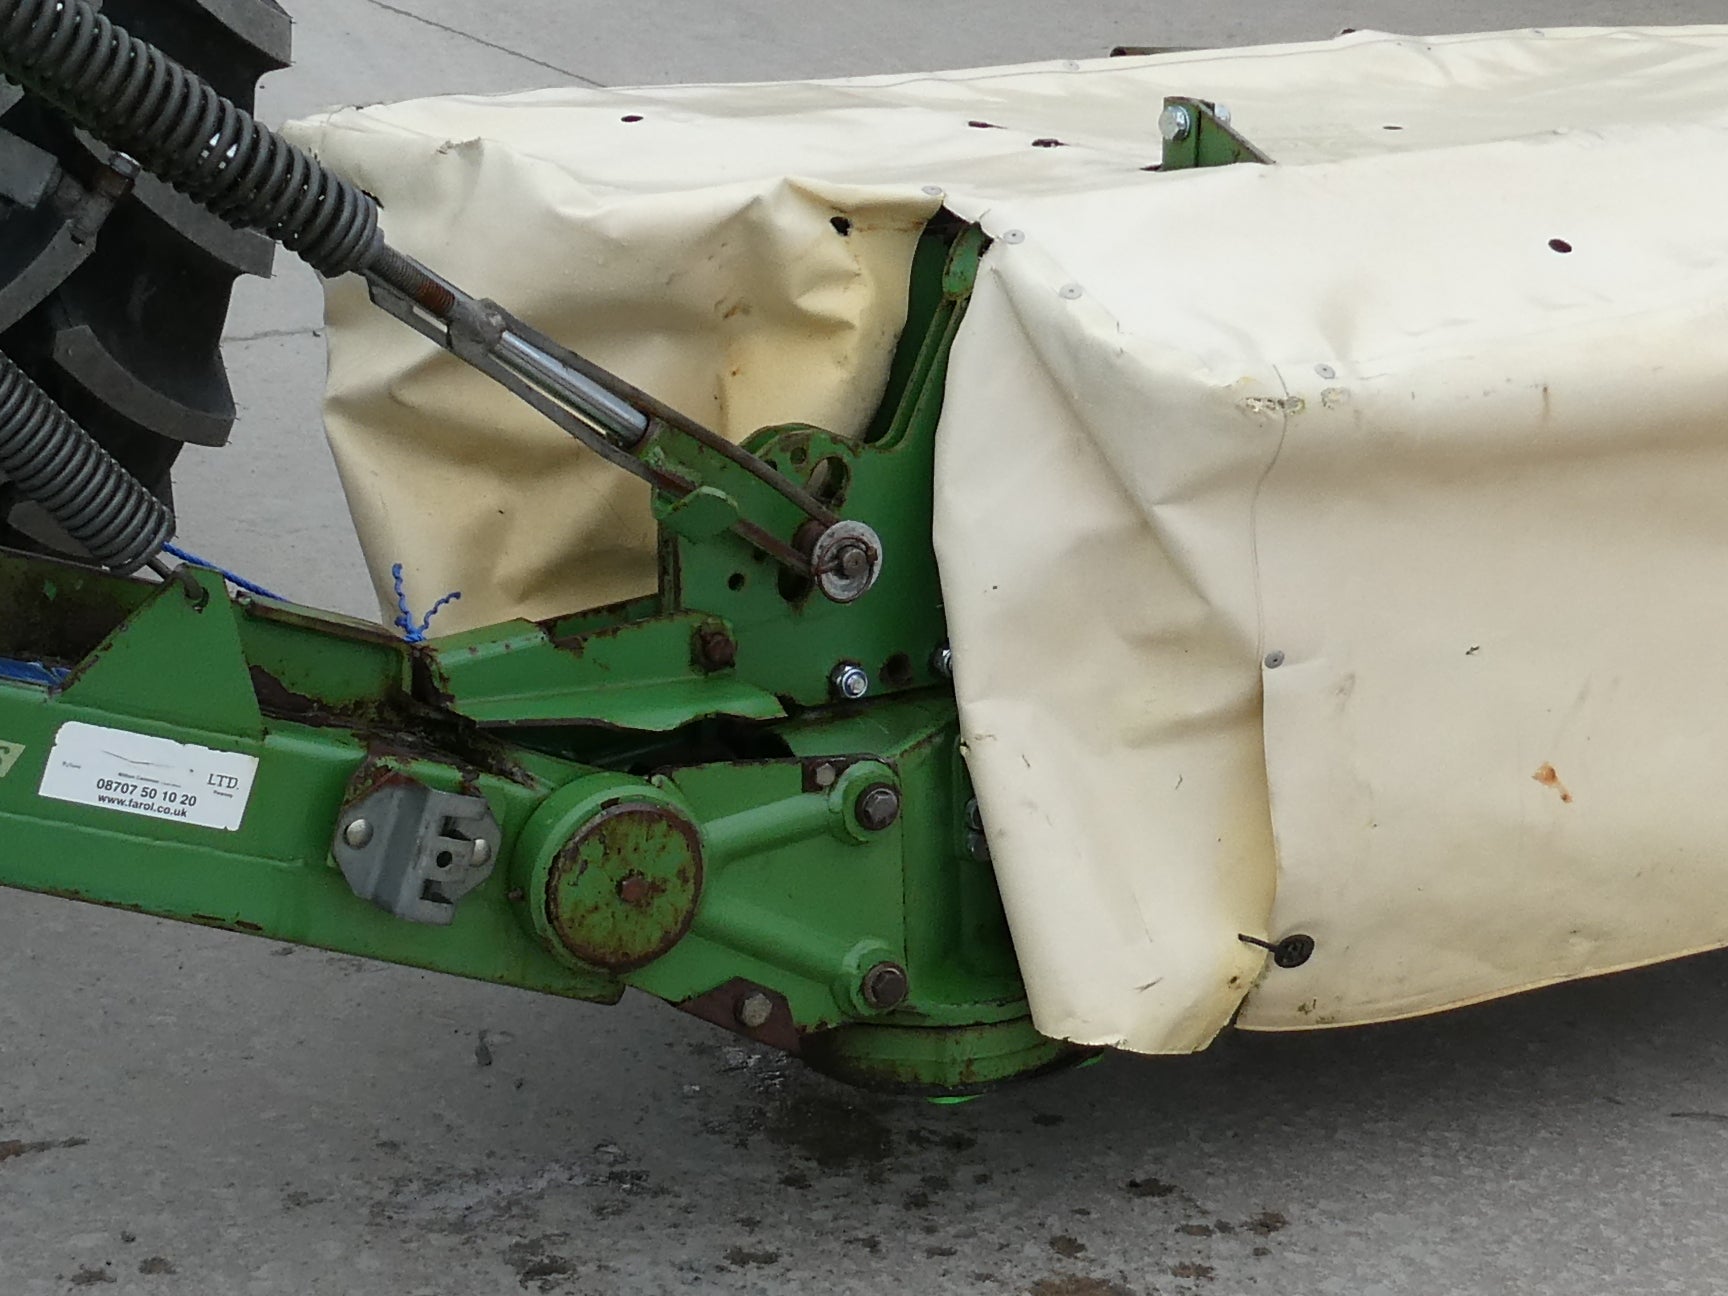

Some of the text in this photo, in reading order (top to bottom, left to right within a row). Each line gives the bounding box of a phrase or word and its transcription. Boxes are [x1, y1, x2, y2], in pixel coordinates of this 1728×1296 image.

[96, 777, 138, 796] 08707
[140, 785, 158, 800] 50
[162, 789, 178, 804] 10
[180, 793, 197, 808] 20
[97, 792, 188, 818] www.farol.co.uk
